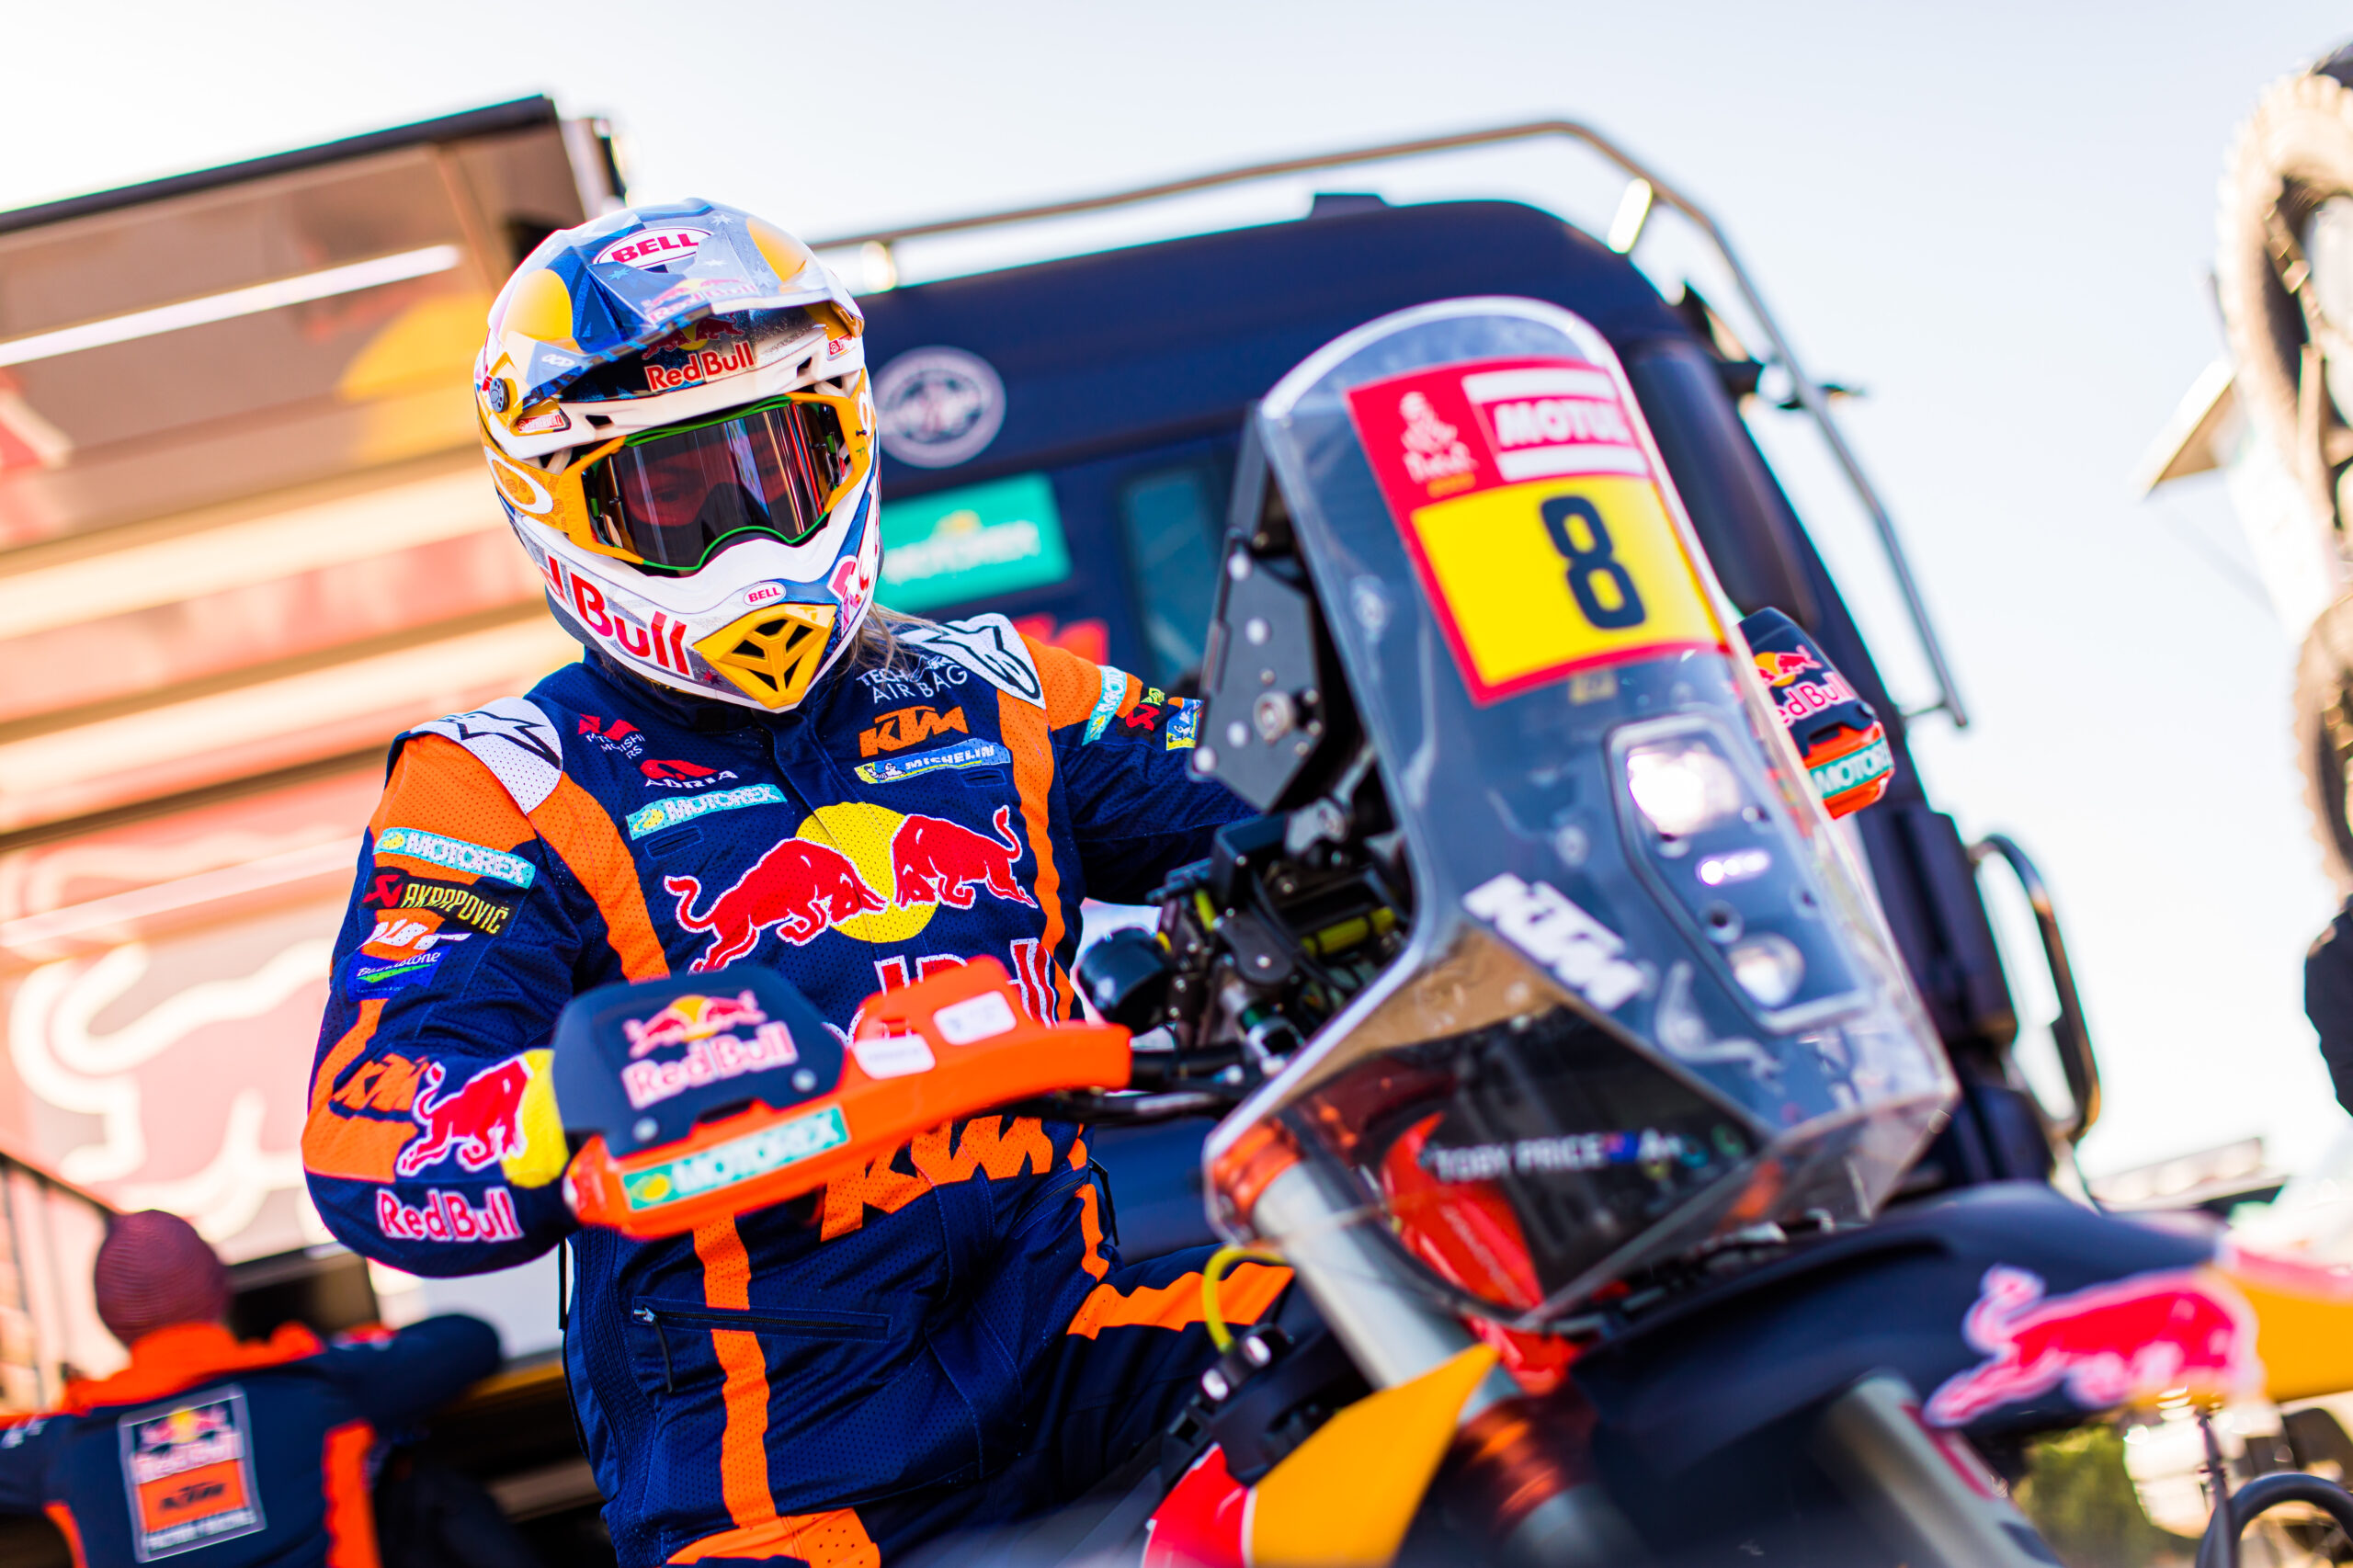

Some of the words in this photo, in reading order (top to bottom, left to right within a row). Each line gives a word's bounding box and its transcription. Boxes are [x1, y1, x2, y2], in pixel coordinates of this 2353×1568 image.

[611, 233, 699, 263] BELL
[645, 354, 703, 392] Red
[700, 341, 756, 379] Bull
[1494, 398, 1631, 448] MOTUL
[1540, 494, 1647, 631] 8
[748, 585, 781, 604] BELL
[570, 571, 691, 676] Bull
[1793, 672, 1856, 712] Bull
[859, 705, 970, 757] KTM
[644, 770, 738, 789] ADRIA
[904, 744, 995, 770] MICHELIN
[664, 785, 780, 822] MOTOREX
[404, 832, 529, 884] MOTOREX
[1461, 871, 1643, 1011] KTM
[620, 1039, 719, 1110] Red
[708, 1020, 800, 1080] Bull
[671, 1109, 841, 1194] MOTOREX
[1516, 1133, 1606, 1173] PRICE
[376, 1187, 453, 1241] Red
[441, 1187, 525, 1243] Bull
